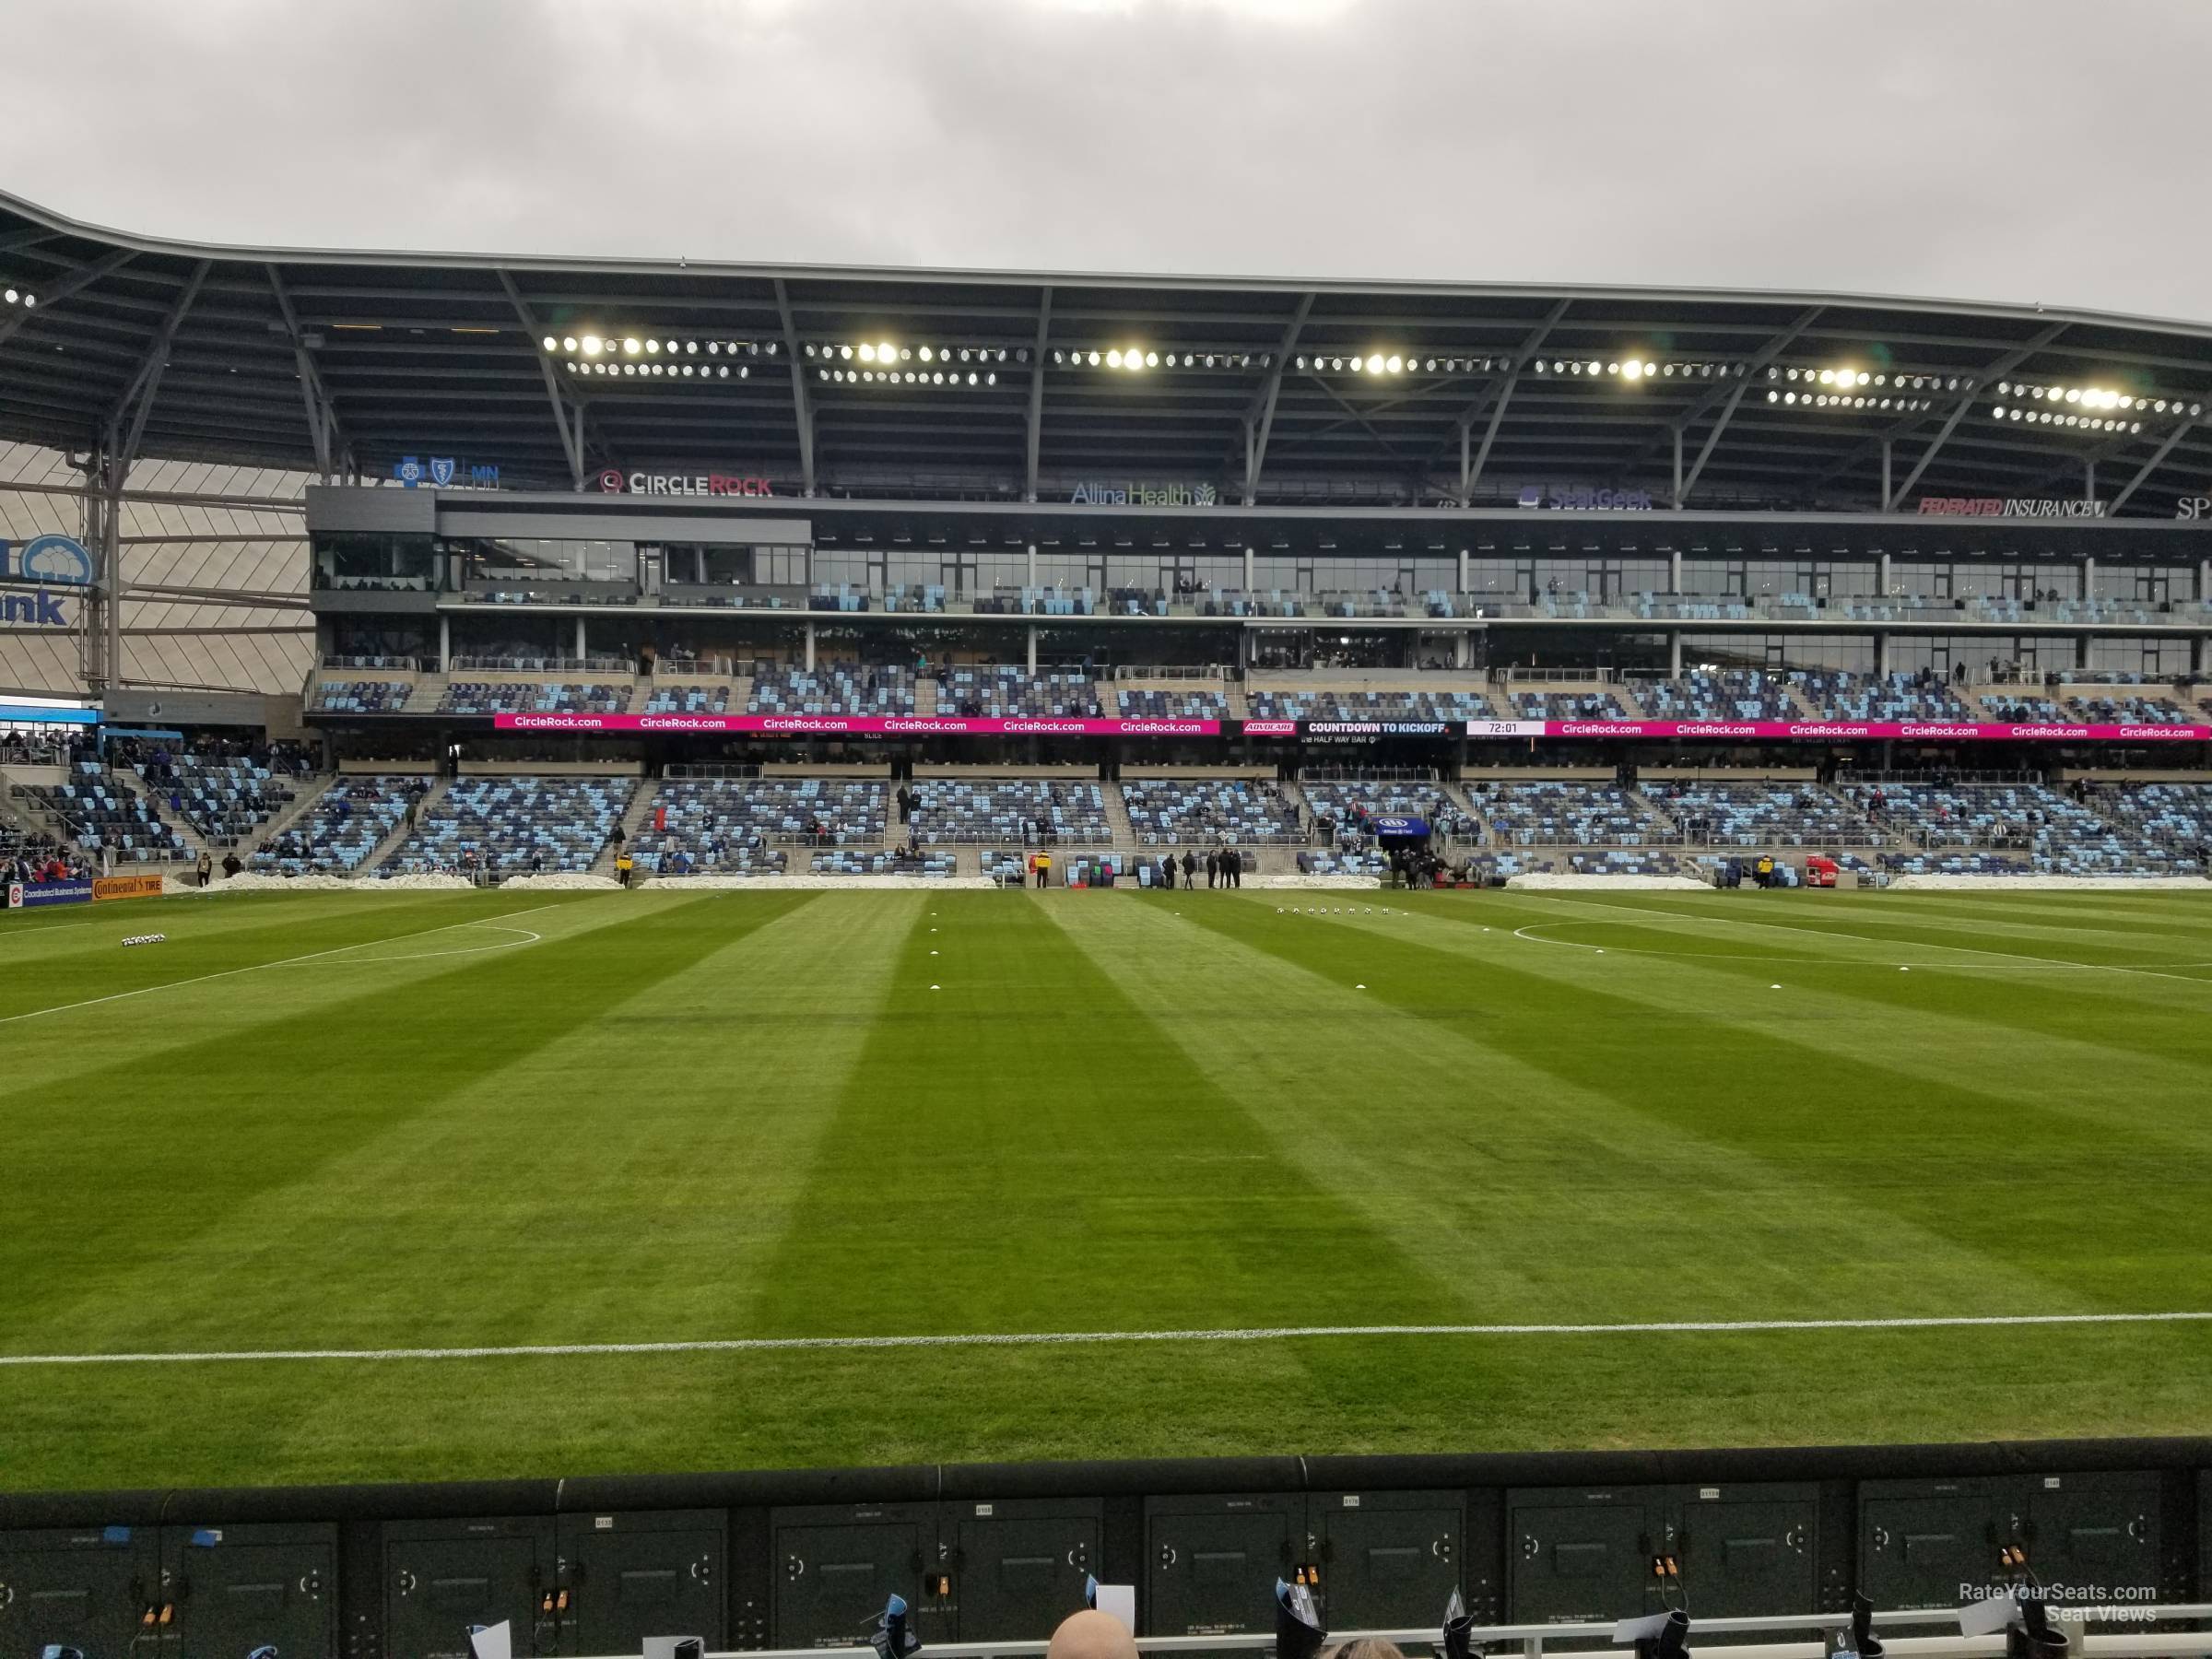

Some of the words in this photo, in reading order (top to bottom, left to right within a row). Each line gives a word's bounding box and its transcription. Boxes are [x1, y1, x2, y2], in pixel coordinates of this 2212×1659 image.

[471, 465, 499, 480] MN
[1549, 488, 1653, 510] SeatGeek
[1917, 497, 2004, 516] FEDERATED
[2003, 499, 2092, 517] INSURANCE
[2177, 497, 2211, 517] SP
[0, 589, 67, 626] nk
[514, 716, 602, 727] CircleRock.com
[640, 718, 726, 728] CircleRock.com
[763, 719, 848, 729] CircleRock.com
[884, 720, 967, 730] CircleRock.com
[1003, 721, 1085, 732] CircleRock.com
[1120, 722, 1201, 732] CircleRock.com
[1244, 723, 1295, 732] ADVOCARE
[1309, 723, 1381, 733] COUNTDOWN
[1382, 723, 1396, 733] TO
[1488, 723, 1517, 733] 72:01
[1562, 724, 1641, 735] CircleRock.com
[1676, 724, 1756, 735] CircleRock.com
[1790, 724, 1867, 735] CircleRock.com
[1901, 725, 1978, 736] CircleRock.com
[2011, 726, 2088, 736] CircleRock.com
[2120, 727, 2194, 737] CircleRock.com
[94, 878, 137, 899] Continental
[145, 880, 161, 891] TIRE
